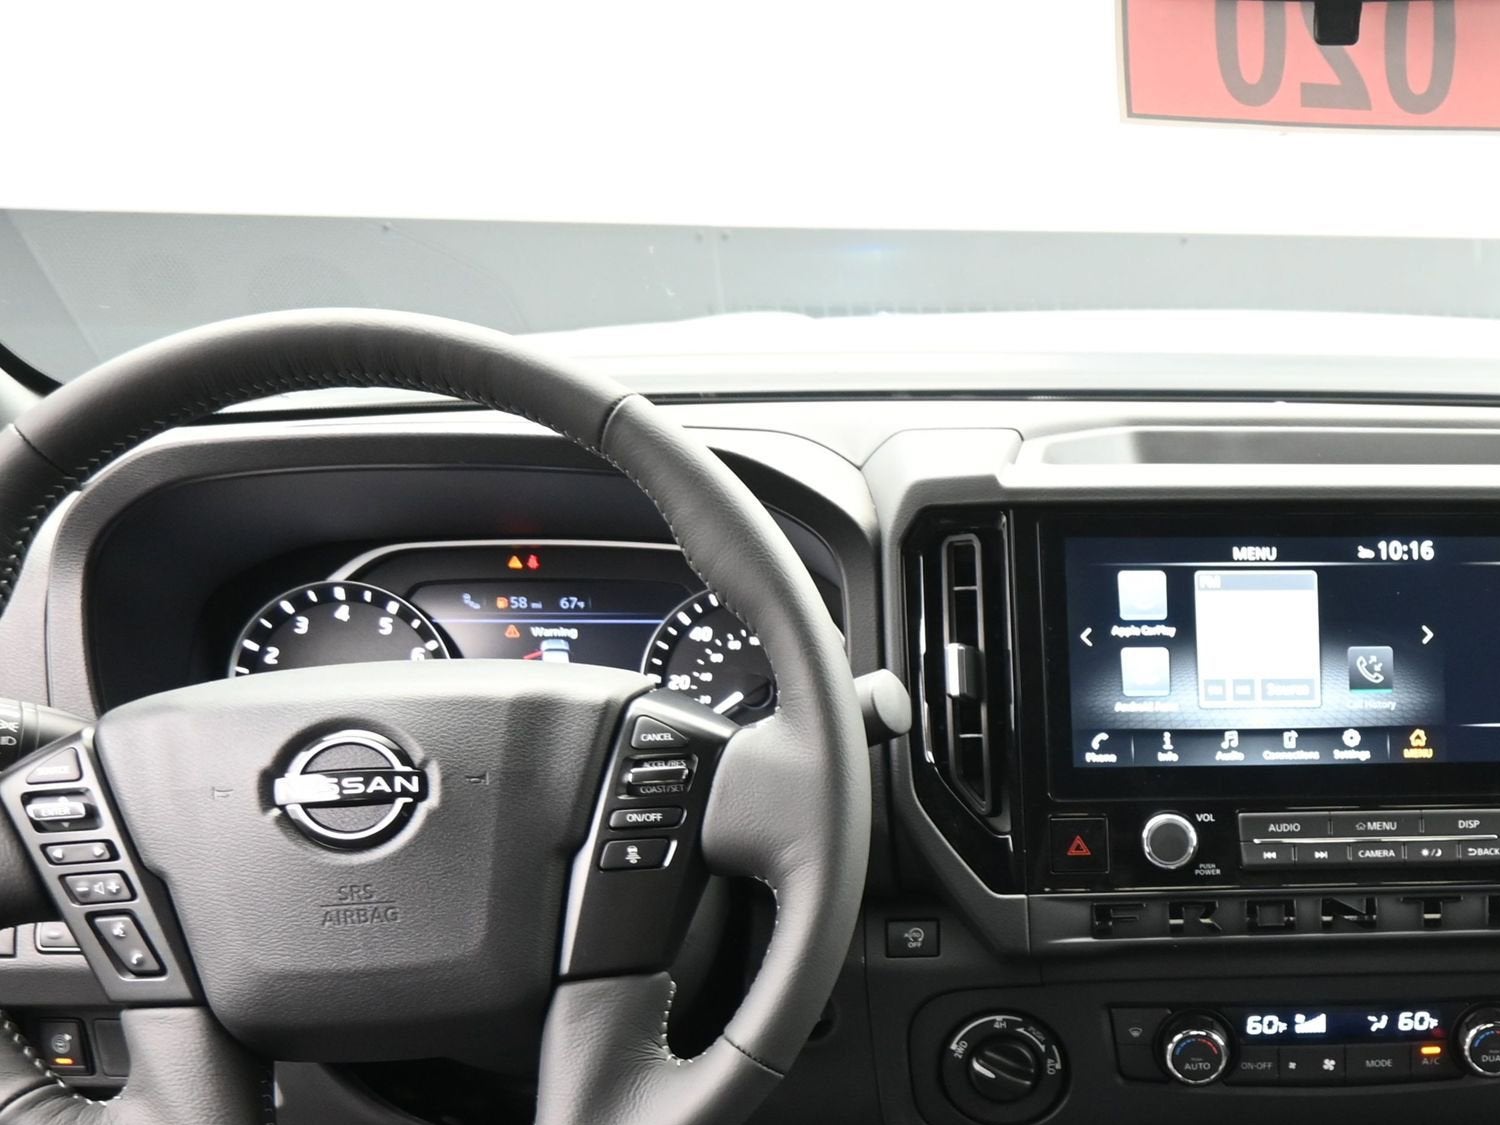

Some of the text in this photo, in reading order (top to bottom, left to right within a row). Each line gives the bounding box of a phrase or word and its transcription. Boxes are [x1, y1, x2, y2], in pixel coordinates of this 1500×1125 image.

[1232, 540, 1435, 560] MENU 10:16
[510, 597, 527, 609] 58
[334, 604, 350, 622] 4
[294, 616, 309, 634] 3
[379, 617, 393, 635] 5
[530, 627, 579, 639] Warning
[689, 626, 713, 642] 40
[263, 647, 279, 664] 2
[410, 647, 425, 661] 6
[668, 674, 691, 690] 20
[640, 733, 674, 742] CANCEL
[642, 759, 687, 768] ACCEL/RES
[282, 775, 420, 797] SSAN
[639, 784, 686, 794] COAST/SET
[626, 813, 663, 823] ON/OFF
[1196, 813, 1216, 823] VOL
[1268, 823, 1301, 832] AUDIO
[1367, 822, 1398, 831] MENU
[1458, 820, 1480, 829] DISP
[1358, 849, 1396, 859] CAMERA
[1477, 847, 1500, 857] BACK
[1194, 868, 1222, 876] POWER
[337, 885, 376, 901] SRS
[320, 908, 399, 926] AIRBAG
[993, 1021, 1007, 1029] 4H
[953, 1040, 968, 1059] 2WD
[1046, 1058, 1057, 1075] 4LO
[1184, 1062, 1211, 1071] AUTO
[1366, 1059, 1393, 1068] MODE
[1422, 1057, 1440, 1066] A/C
